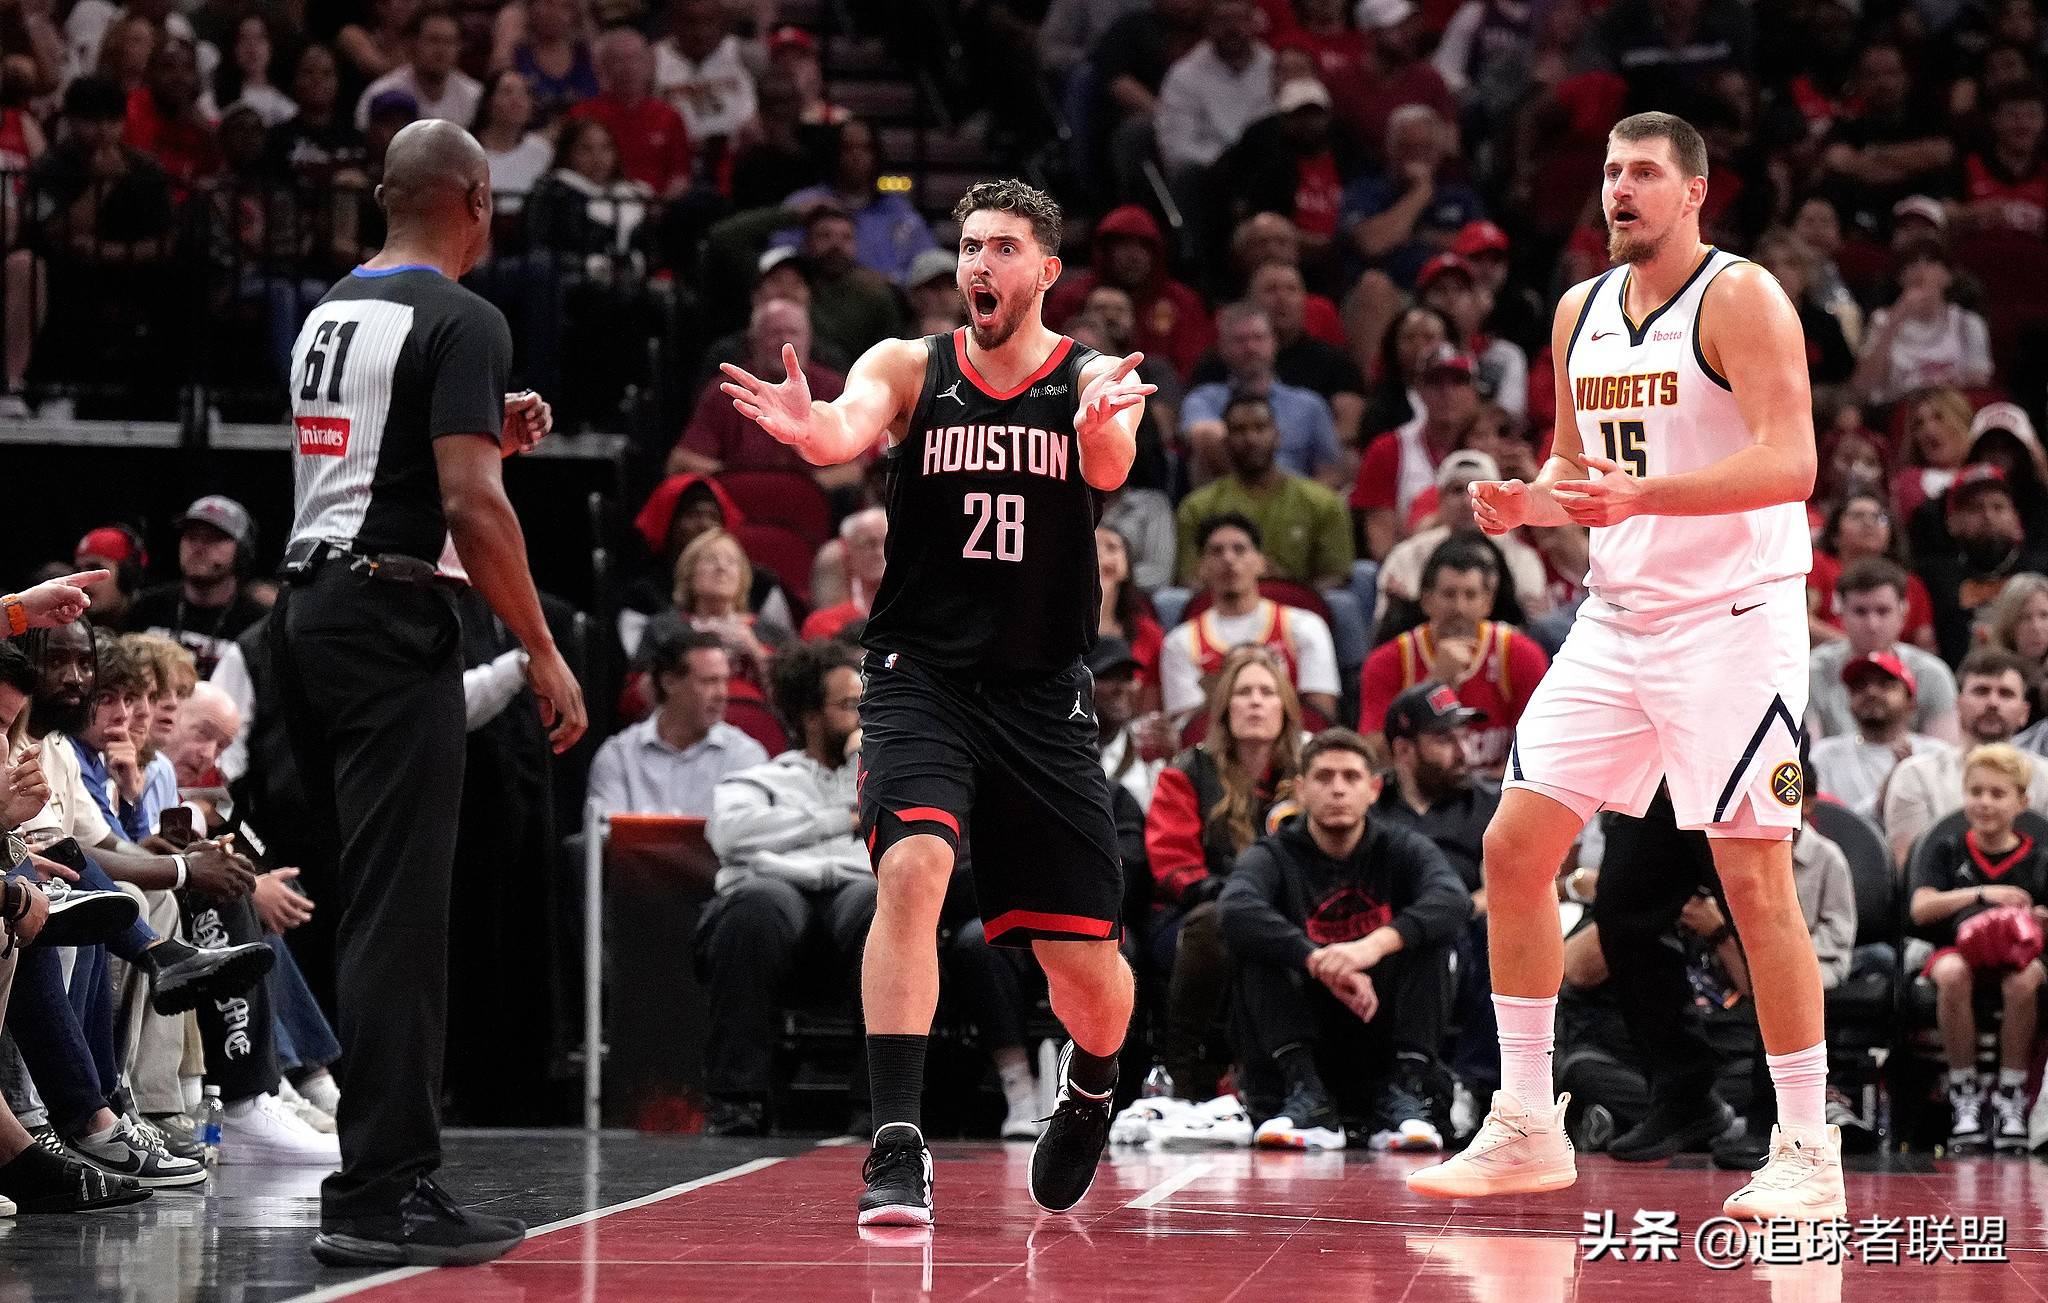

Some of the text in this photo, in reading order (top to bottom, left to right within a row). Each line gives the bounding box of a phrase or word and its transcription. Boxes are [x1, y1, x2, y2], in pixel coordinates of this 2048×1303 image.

[301, 320, 359, 403] 61
[1576, 371, 1679, 411] NUGGETS
[922, 424, 1070, 482] HOUSTON
[1600, 420, 1647, 478] 15
[962, 492, 1025, 562] 28
